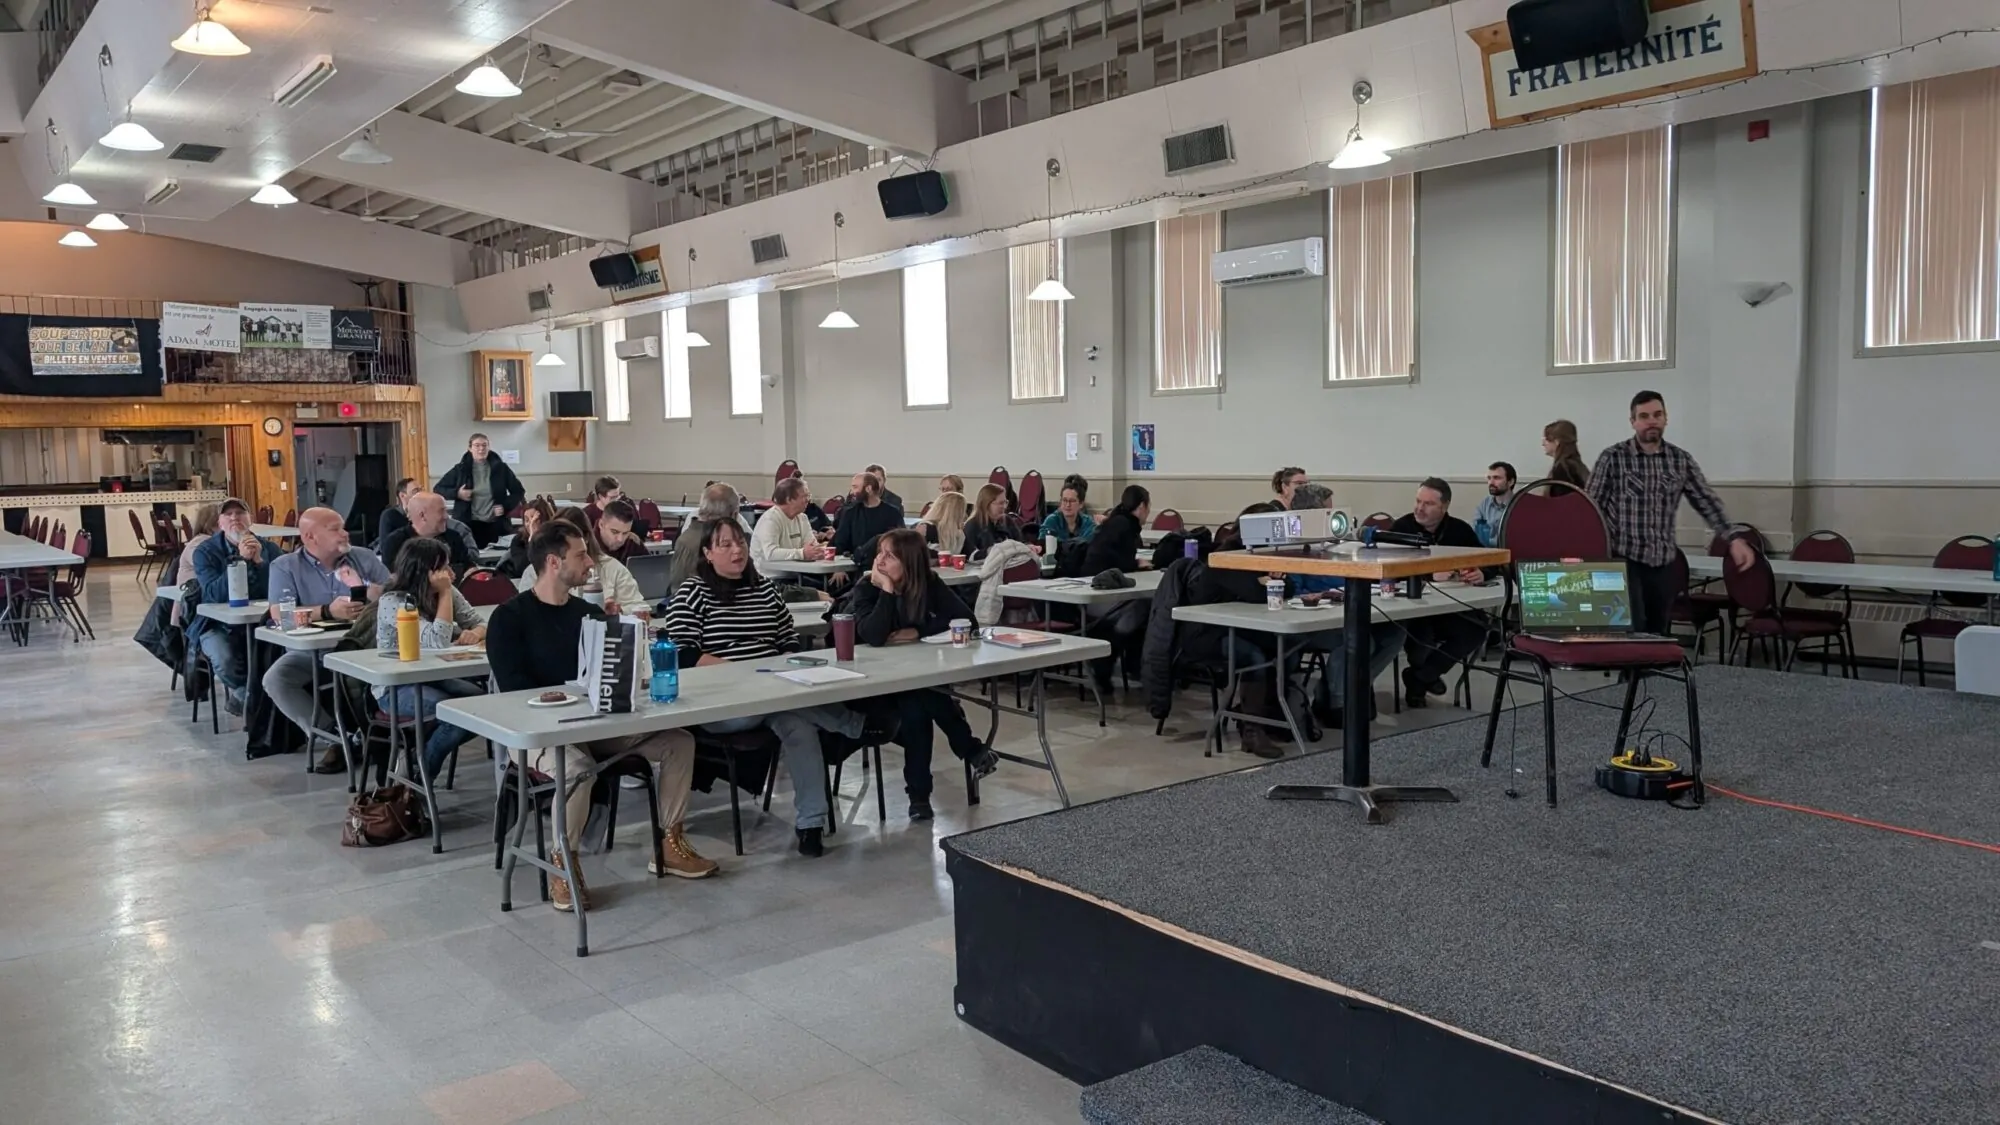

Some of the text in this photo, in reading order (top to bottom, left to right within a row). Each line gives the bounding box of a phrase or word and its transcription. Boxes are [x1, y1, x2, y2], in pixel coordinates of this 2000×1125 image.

[1507, 13, 1723, 97] FRATERNITÉ
[30, 327, 88, 340] SOUPER
[337, 326, 373, 334] MOUNTAIN
[166, 335, 239, 348] ADAM MOTEL
[44, 355, 77, 364] BILLETS
[78, 355, 90, 364] EN
[91, 355, 117, 364] VENTE
